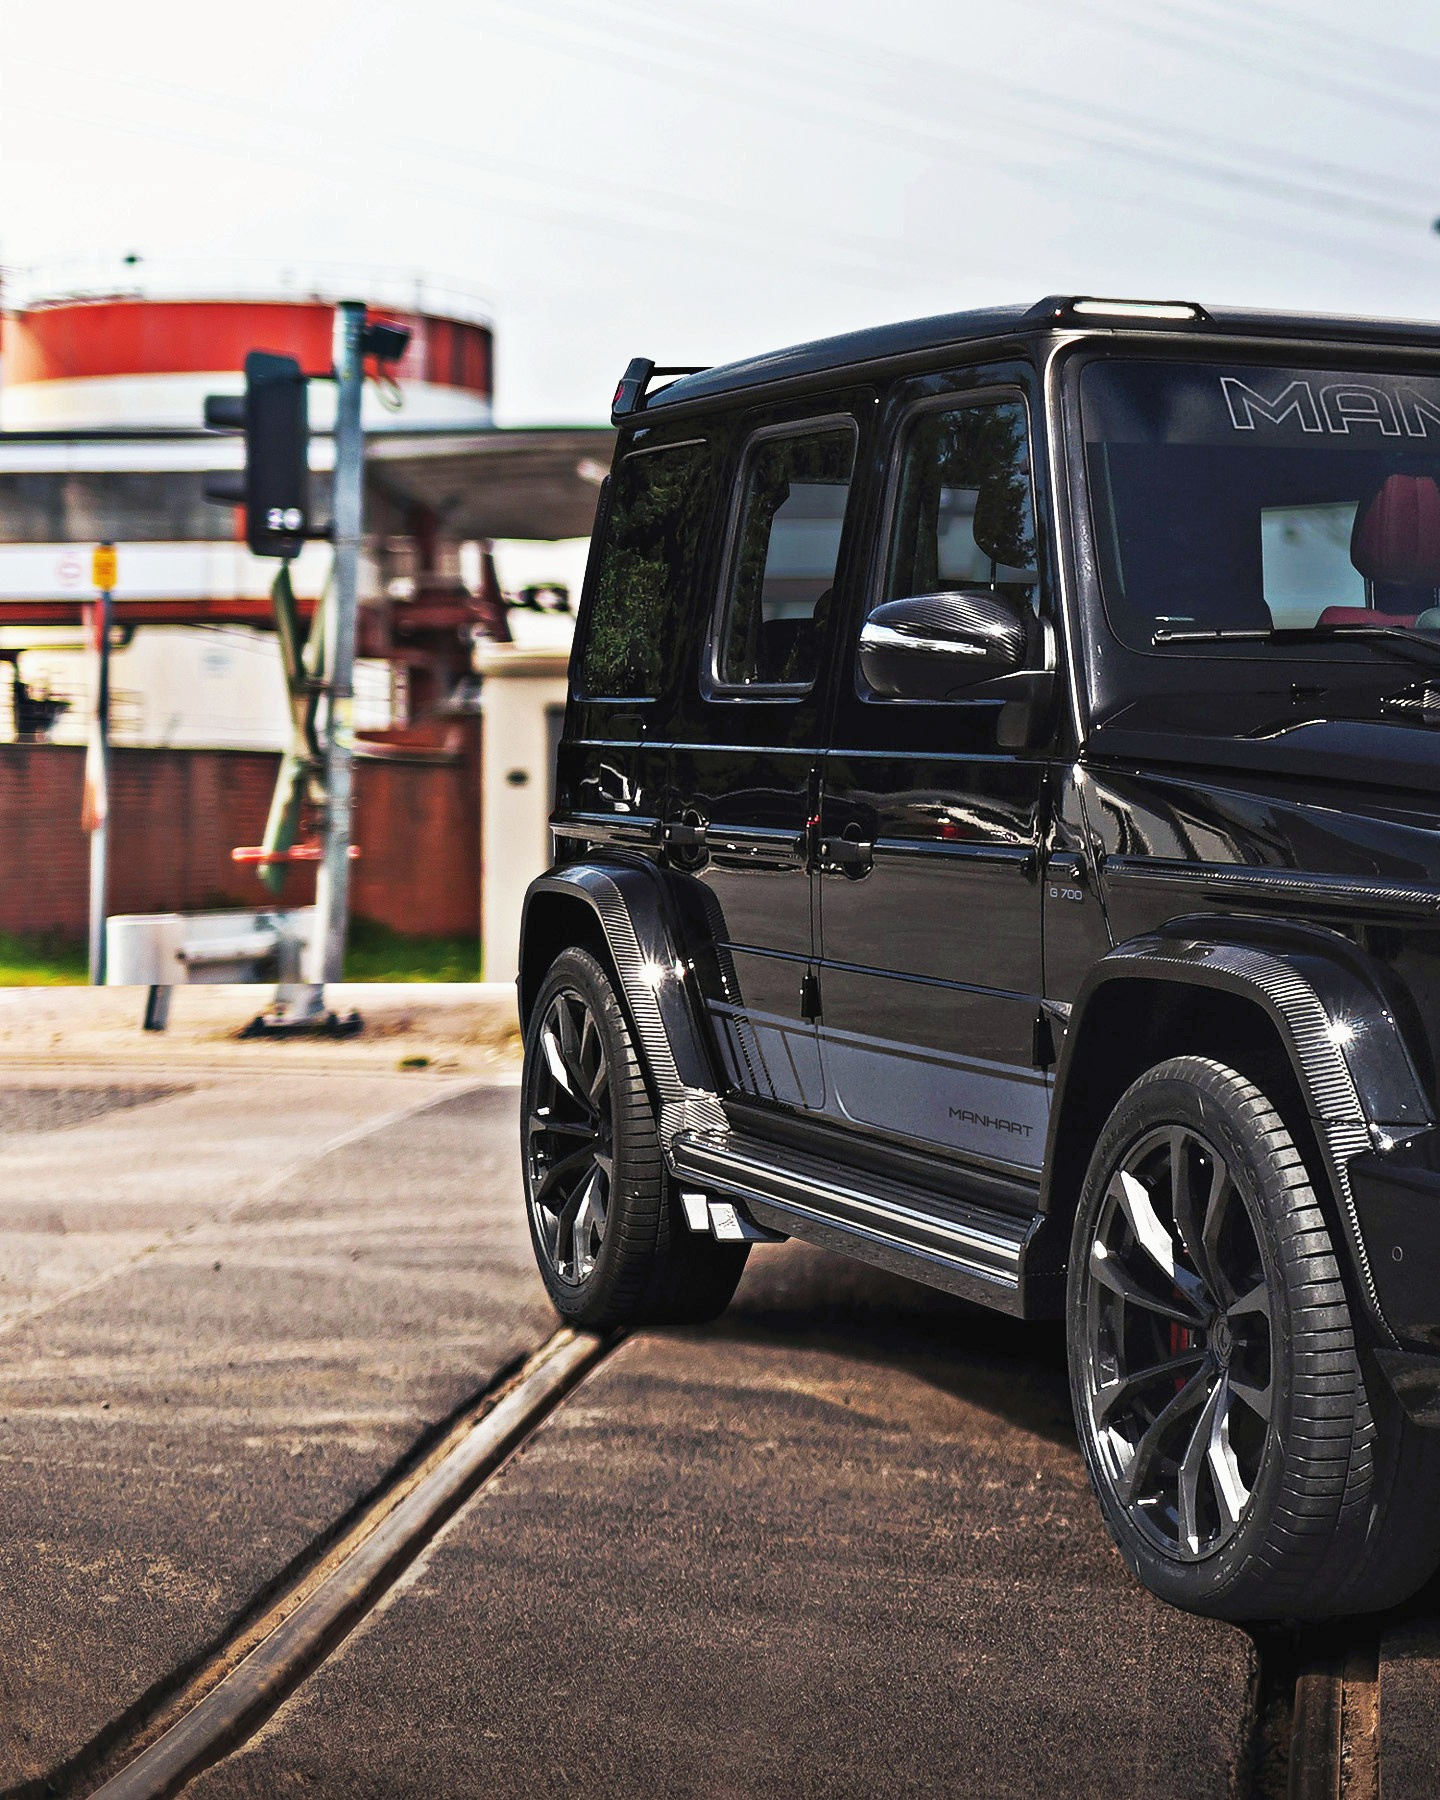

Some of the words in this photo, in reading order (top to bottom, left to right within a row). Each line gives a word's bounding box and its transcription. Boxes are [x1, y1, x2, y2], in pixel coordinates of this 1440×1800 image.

[1049, 887, 1058, 898] G
[1060, 888, 1083, 900] 700
[948, 1106, 1034, 1137] MANHART
